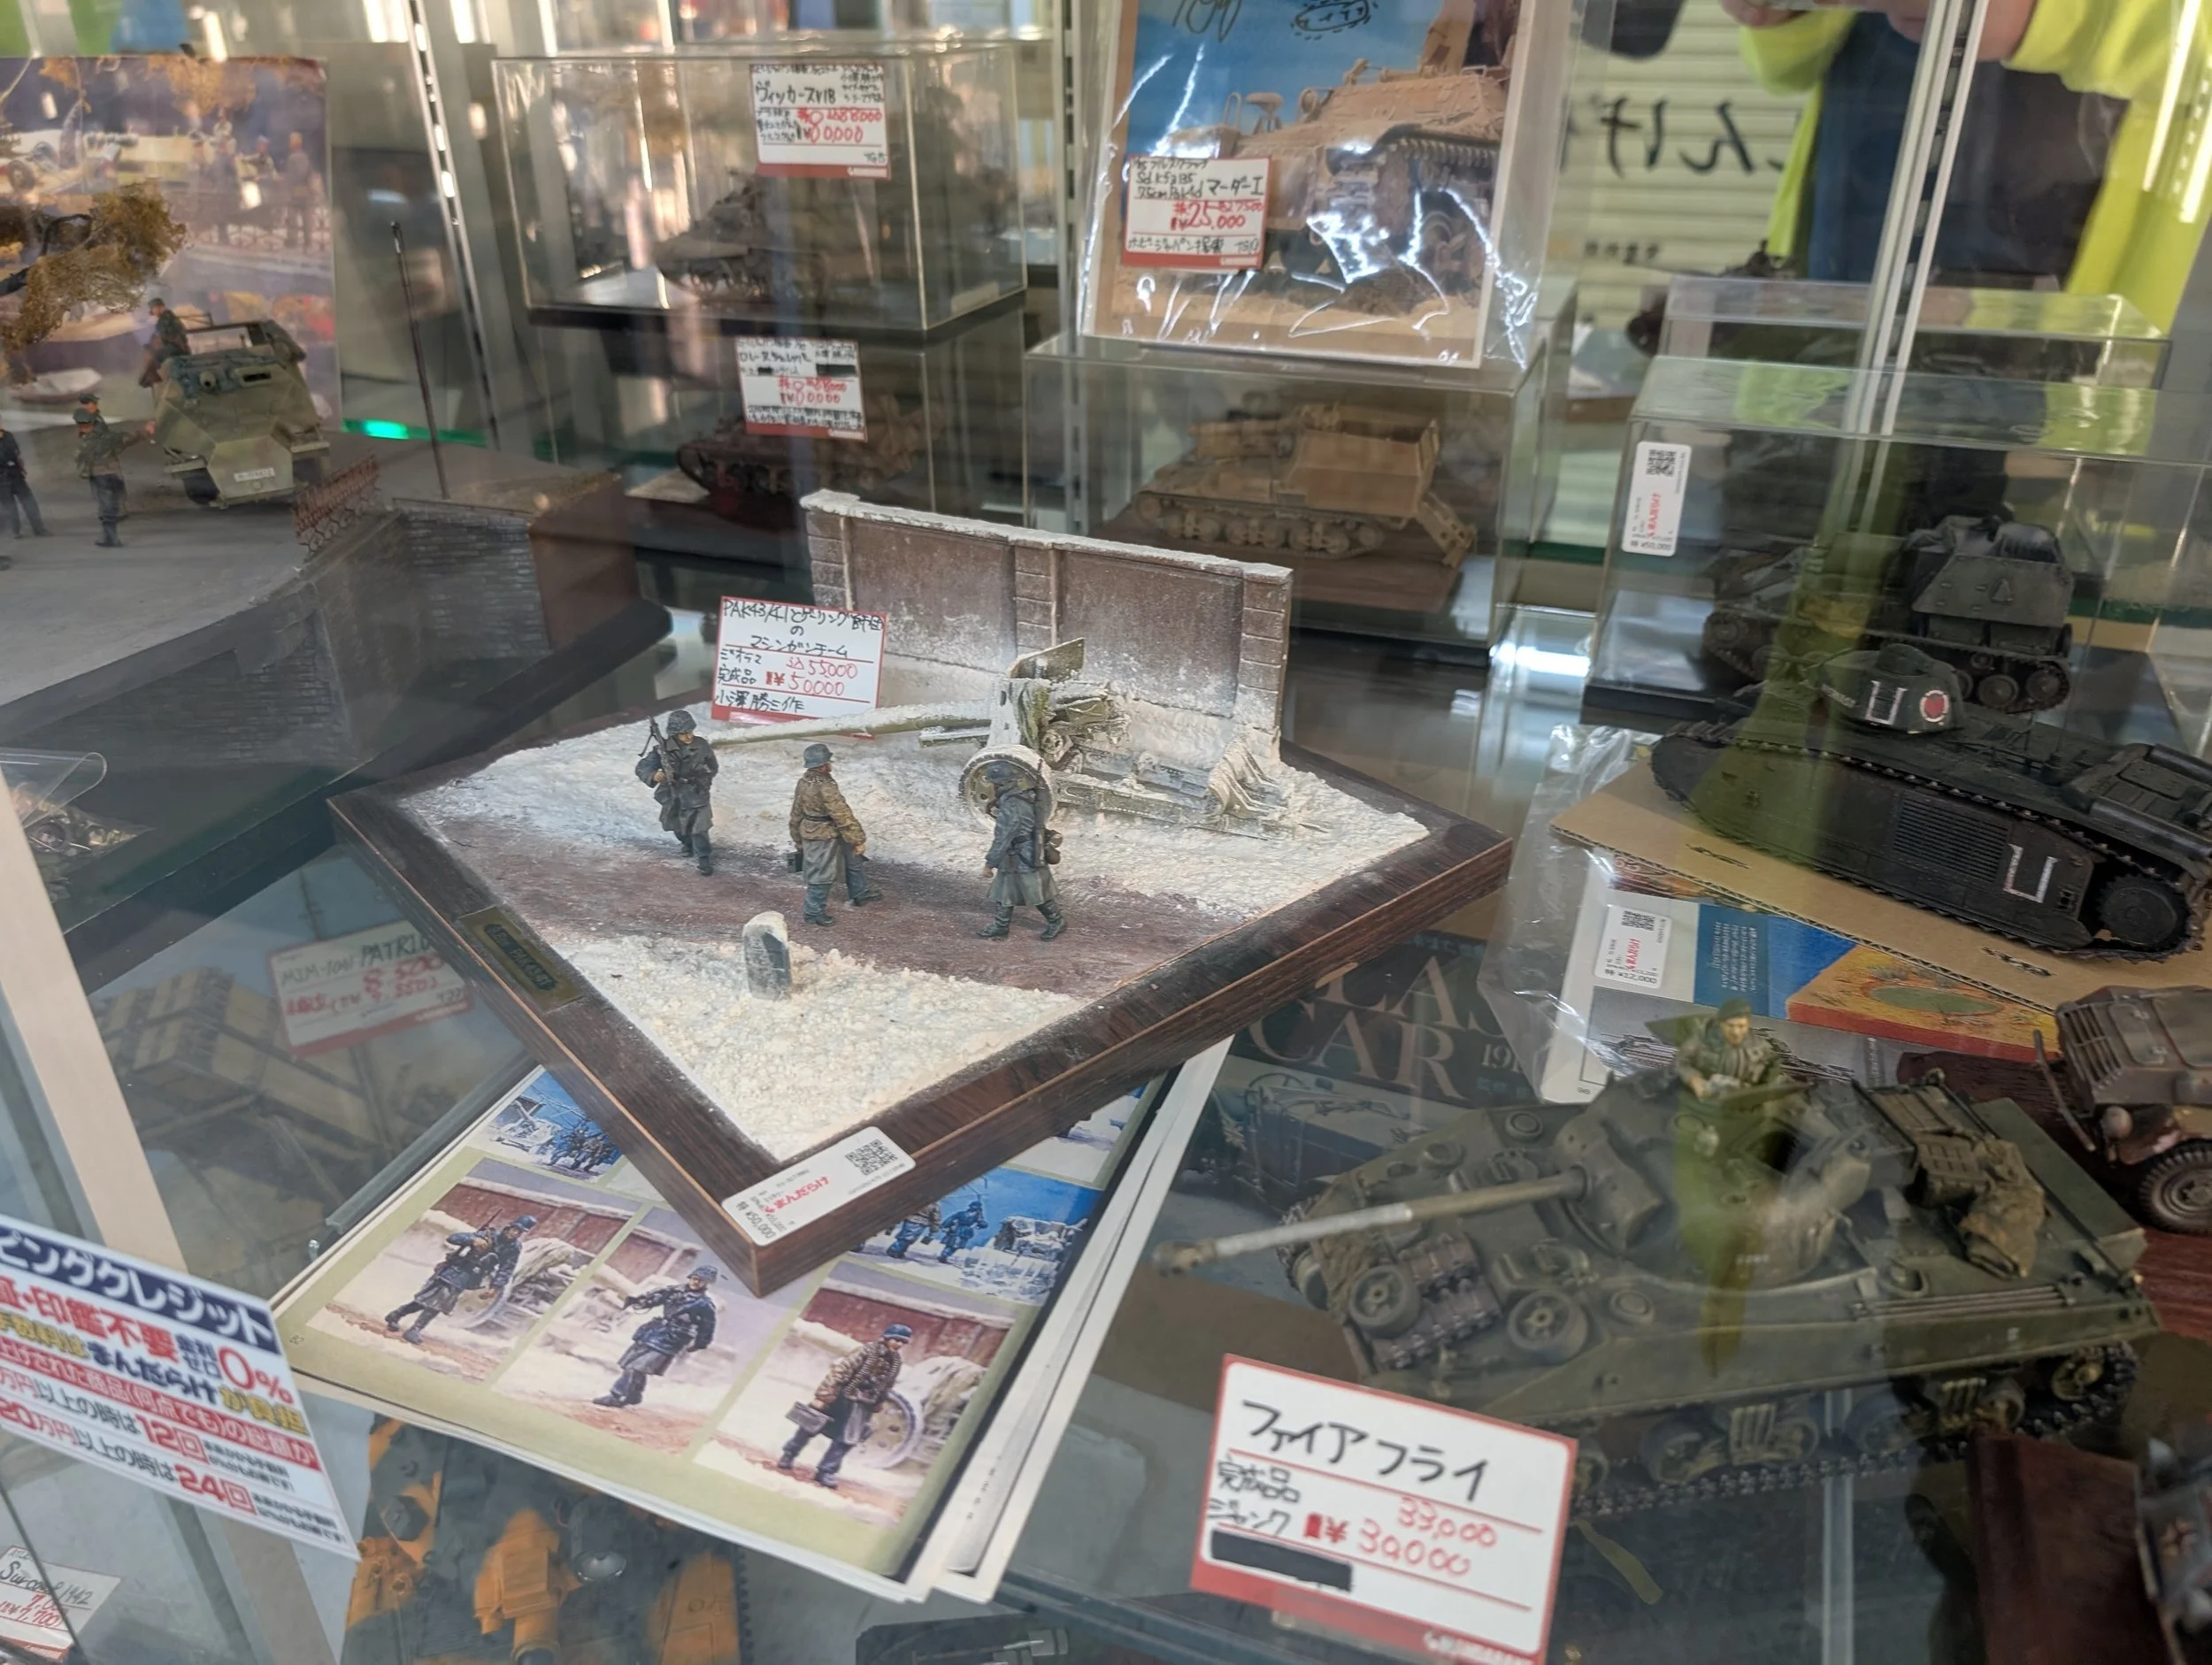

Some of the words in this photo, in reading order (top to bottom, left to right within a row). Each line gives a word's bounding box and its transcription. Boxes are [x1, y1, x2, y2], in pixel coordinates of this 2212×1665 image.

[789, 625, 805, 637] の
[1217, 1454, 1302, 1504] 完成品
[1207, 1497, 1292, 1538] ジャンク
